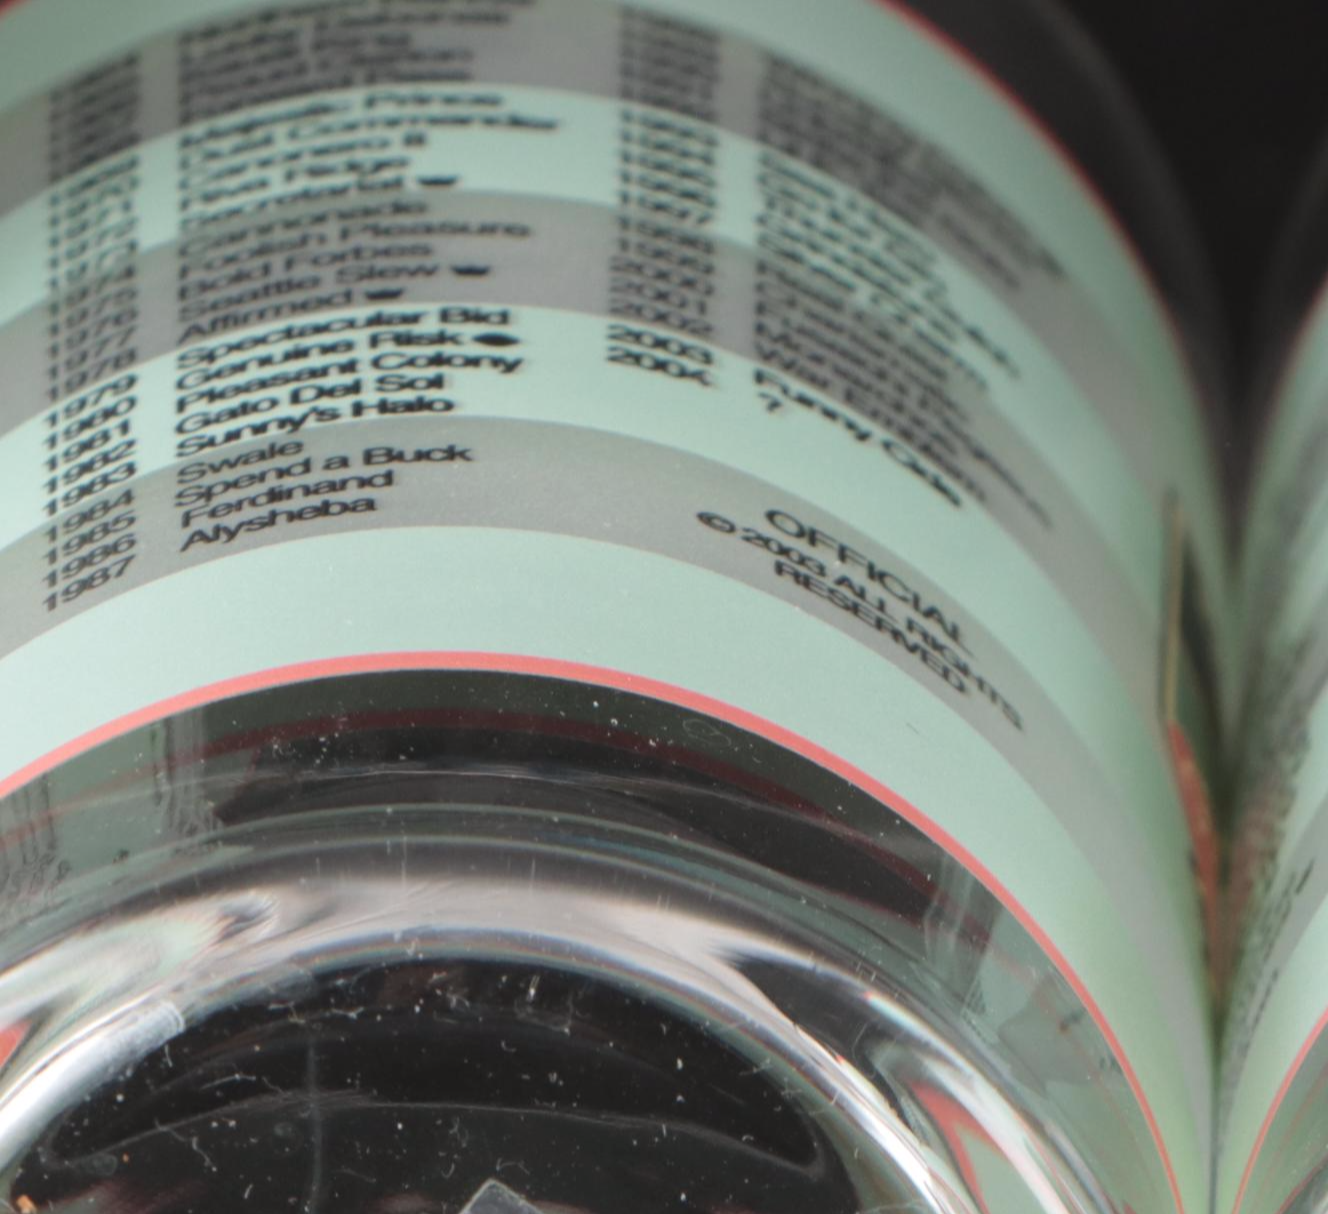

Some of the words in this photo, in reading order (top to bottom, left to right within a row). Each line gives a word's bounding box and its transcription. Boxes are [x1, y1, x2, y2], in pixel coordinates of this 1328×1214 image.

[44, 372, 138, 428] 1979
[177, 311, 425, 370] Spectacular
[439, 306, 512, 326] Bid
[175, 339, 355, 391] Genuine
[369, 331, 465, 350] Risk
[606, 323, 713, 365] 2003
[42, 438, 138, 495] 1982
[174, 397, 280, 435] Gato
[290, 379, 362, 405] Del
[376, 374, 446, 391] Sol
[42, 461, 138, 517] 1983
[174, 405, 341, 458] Sunny's
[352, 396, 456, 418] Halo
[43, 419, 132, 471] 1981
[175, 358, 358, 415] Pleasant
[371, 350, 525, 374] Colony
[42, 488, 136, 543] 1984
[177, 440, 305, 484] Swale
[42, 509, 136, 566] 1985
[174, 456, 312, 508] Spend
[322, 454, 350, 470] a
[363, 444, 474, 465] Buck
[42, 532, 137, 588] 1986
[182, 469, 396, 530] Ferdinand
[42, 553, 137, 612] 1987
[180, 496, 377, 553] Alysheba
[765, 508, 978, 662] OFFICIAL
[740, 526, 827, 577] 2003
[834, 574, 902, 626] ALL
[905, 617, 1023, 731] RIGHTS
[774, 559, 968, 695] RESERVED
